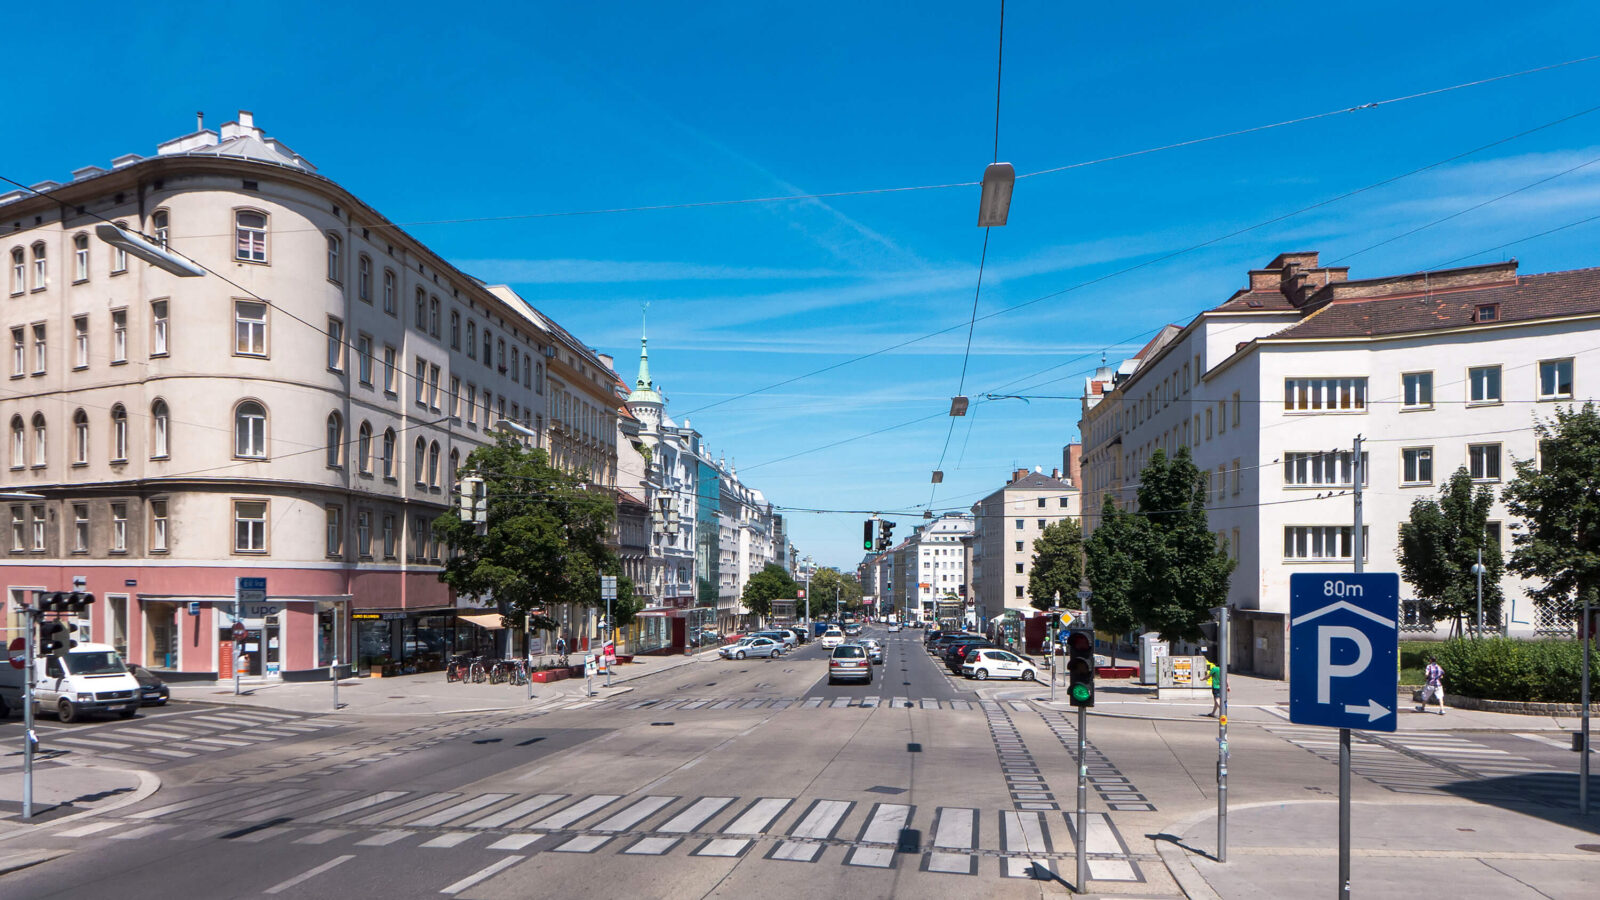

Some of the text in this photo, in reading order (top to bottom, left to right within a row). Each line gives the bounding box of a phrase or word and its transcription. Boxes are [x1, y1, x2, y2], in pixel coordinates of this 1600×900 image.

[1323, 580, 1363, 597] 80m
[251, 606, 277, 617] upc
[1317, 625, 1373, 704] P
